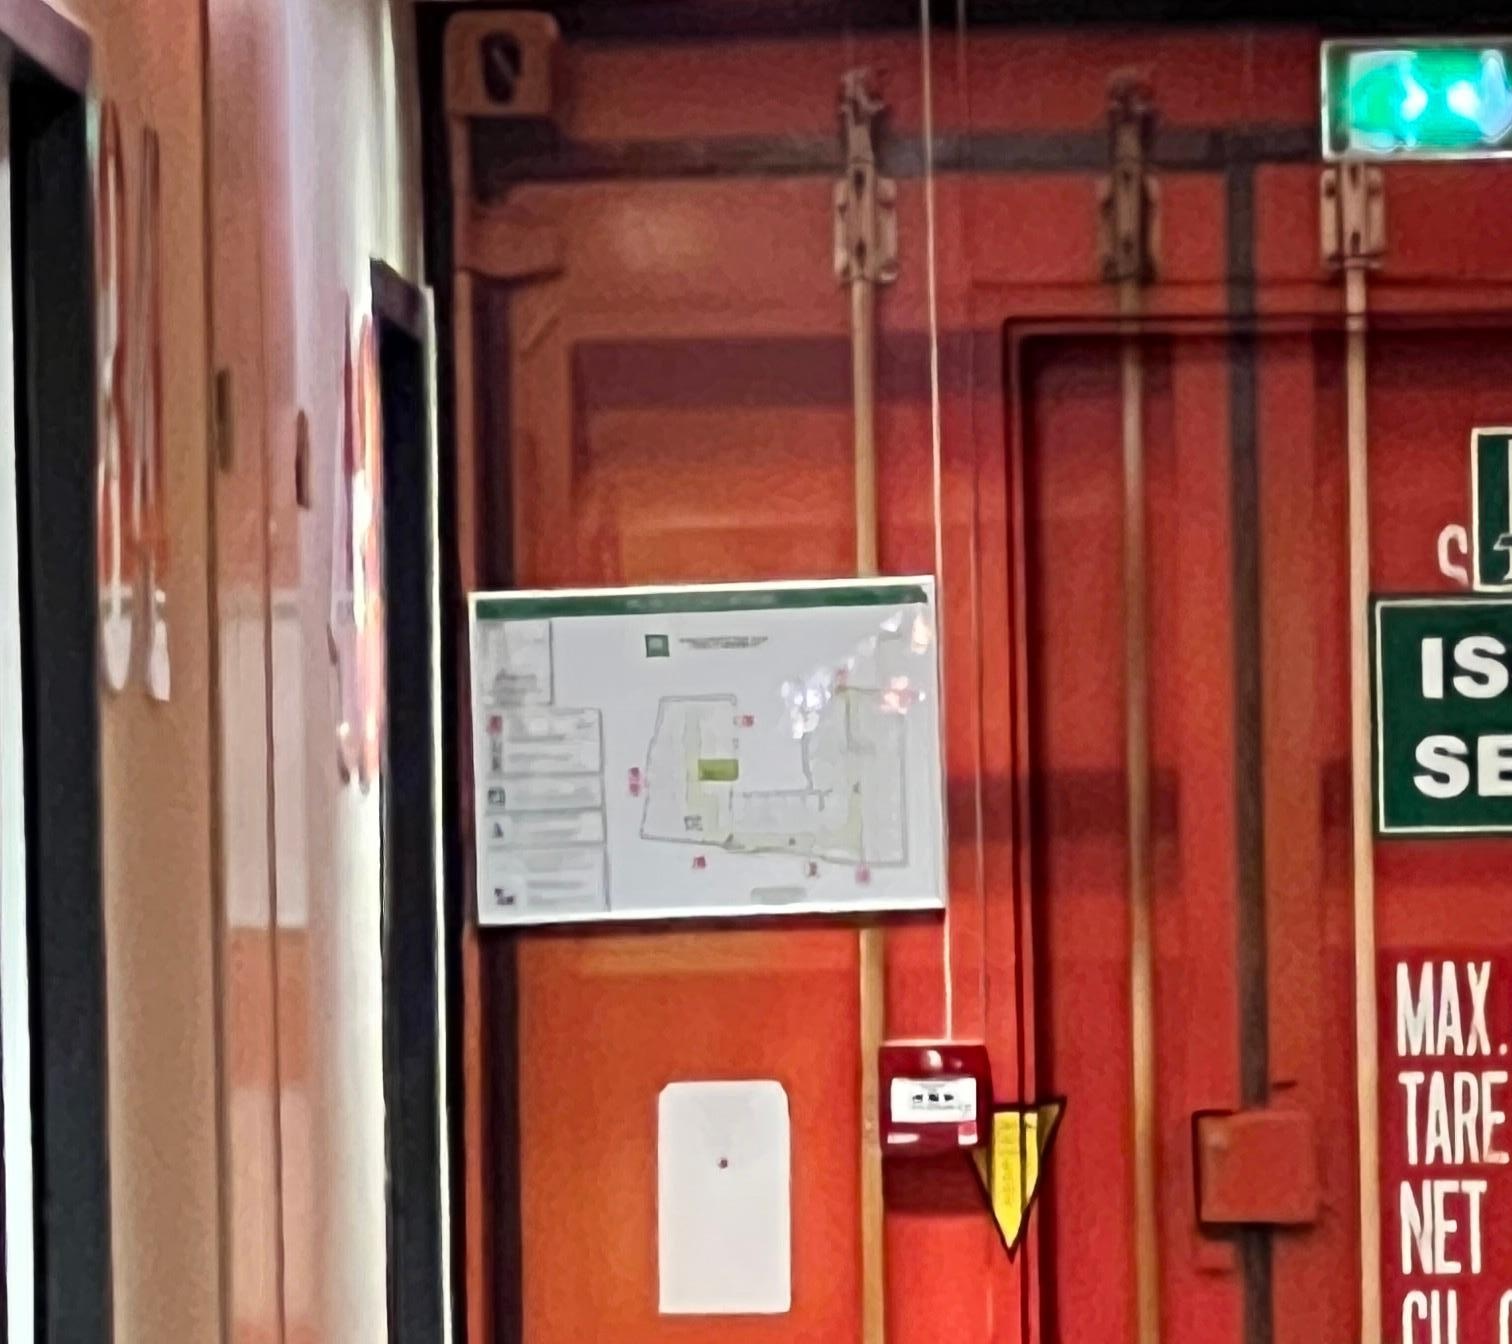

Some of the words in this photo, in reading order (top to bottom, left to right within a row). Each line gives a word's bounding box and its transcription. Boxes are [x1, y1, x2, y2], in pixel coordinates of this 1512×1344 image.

[1396, 960, 1508, 1057] MAX.
[1398, 1070, 1510, 1166] TARE
[1399, 1179, 1488, 1275] NET
